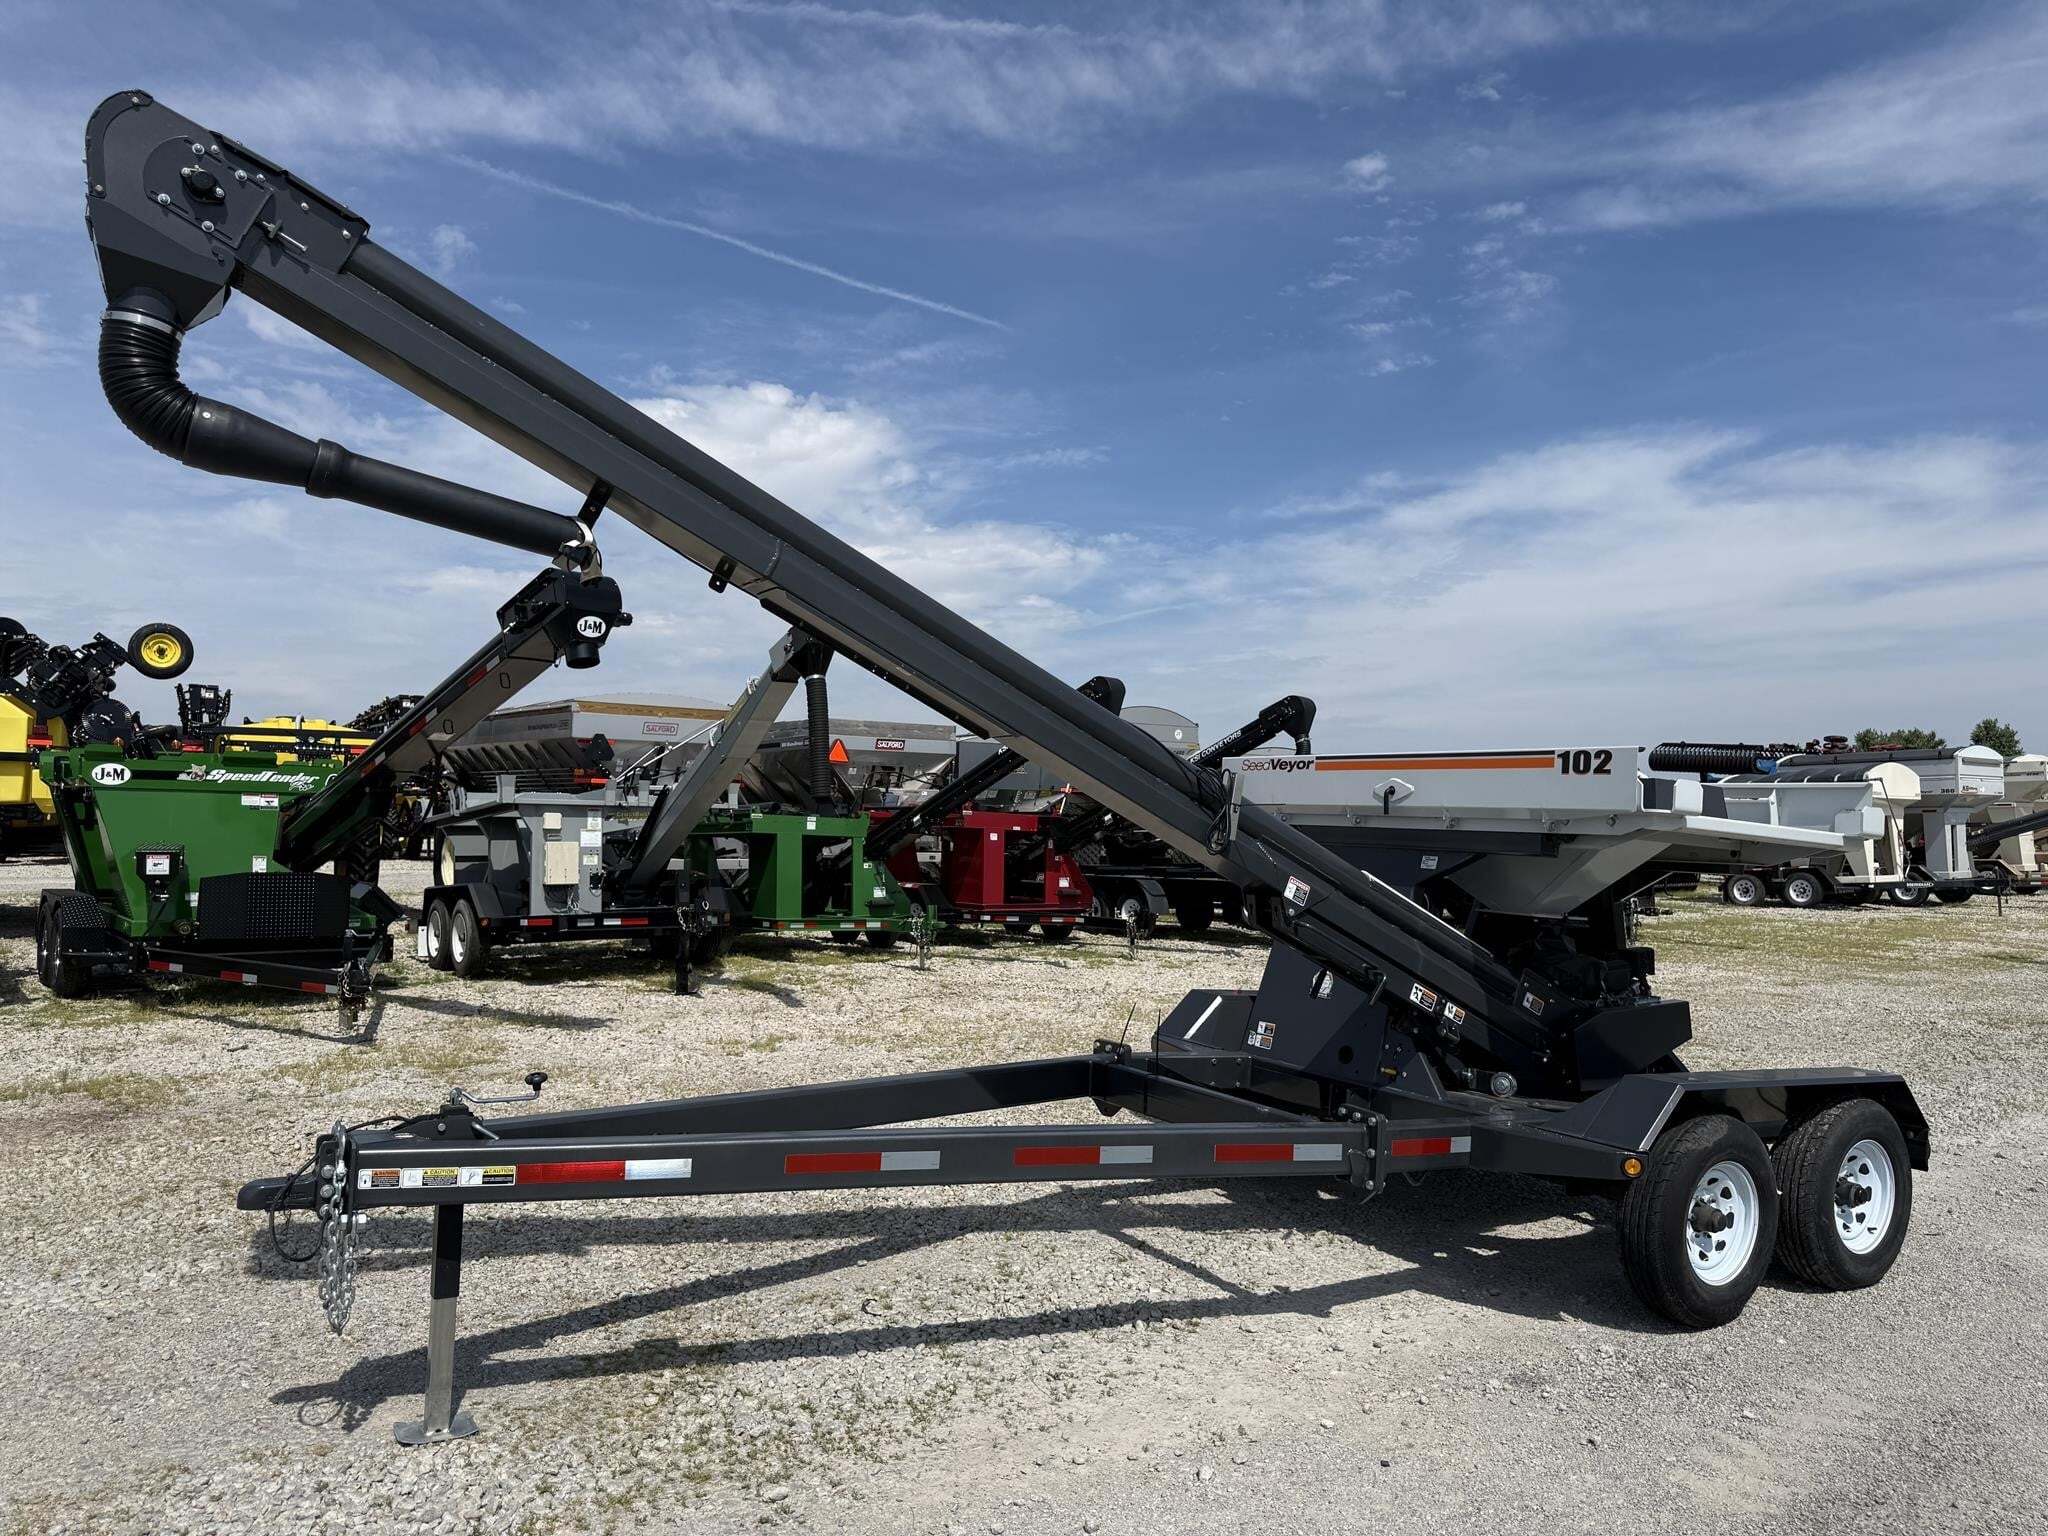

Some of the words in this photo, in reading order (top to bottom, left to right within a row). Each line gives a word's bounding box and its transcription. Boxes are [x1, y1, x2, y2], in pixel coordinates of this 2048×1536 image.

[579, 619, 602, 634] J&M
[645, 724, 676, 734] SALFORD
[876, 740, 904, 749] SALFORD
[1201, 730, 1242, 758] CONVEYORS
[1241, 758, 1315, 773] SeedVeyor
[1557, 749, 1613, 775] 102
[95, 767, 126, 781] J&M
[206, 769, 320, 785] SpeedTender
[429, 1168, 456, 1176] CAUTION
[487, 1167, 514, 1175] CAUTION
